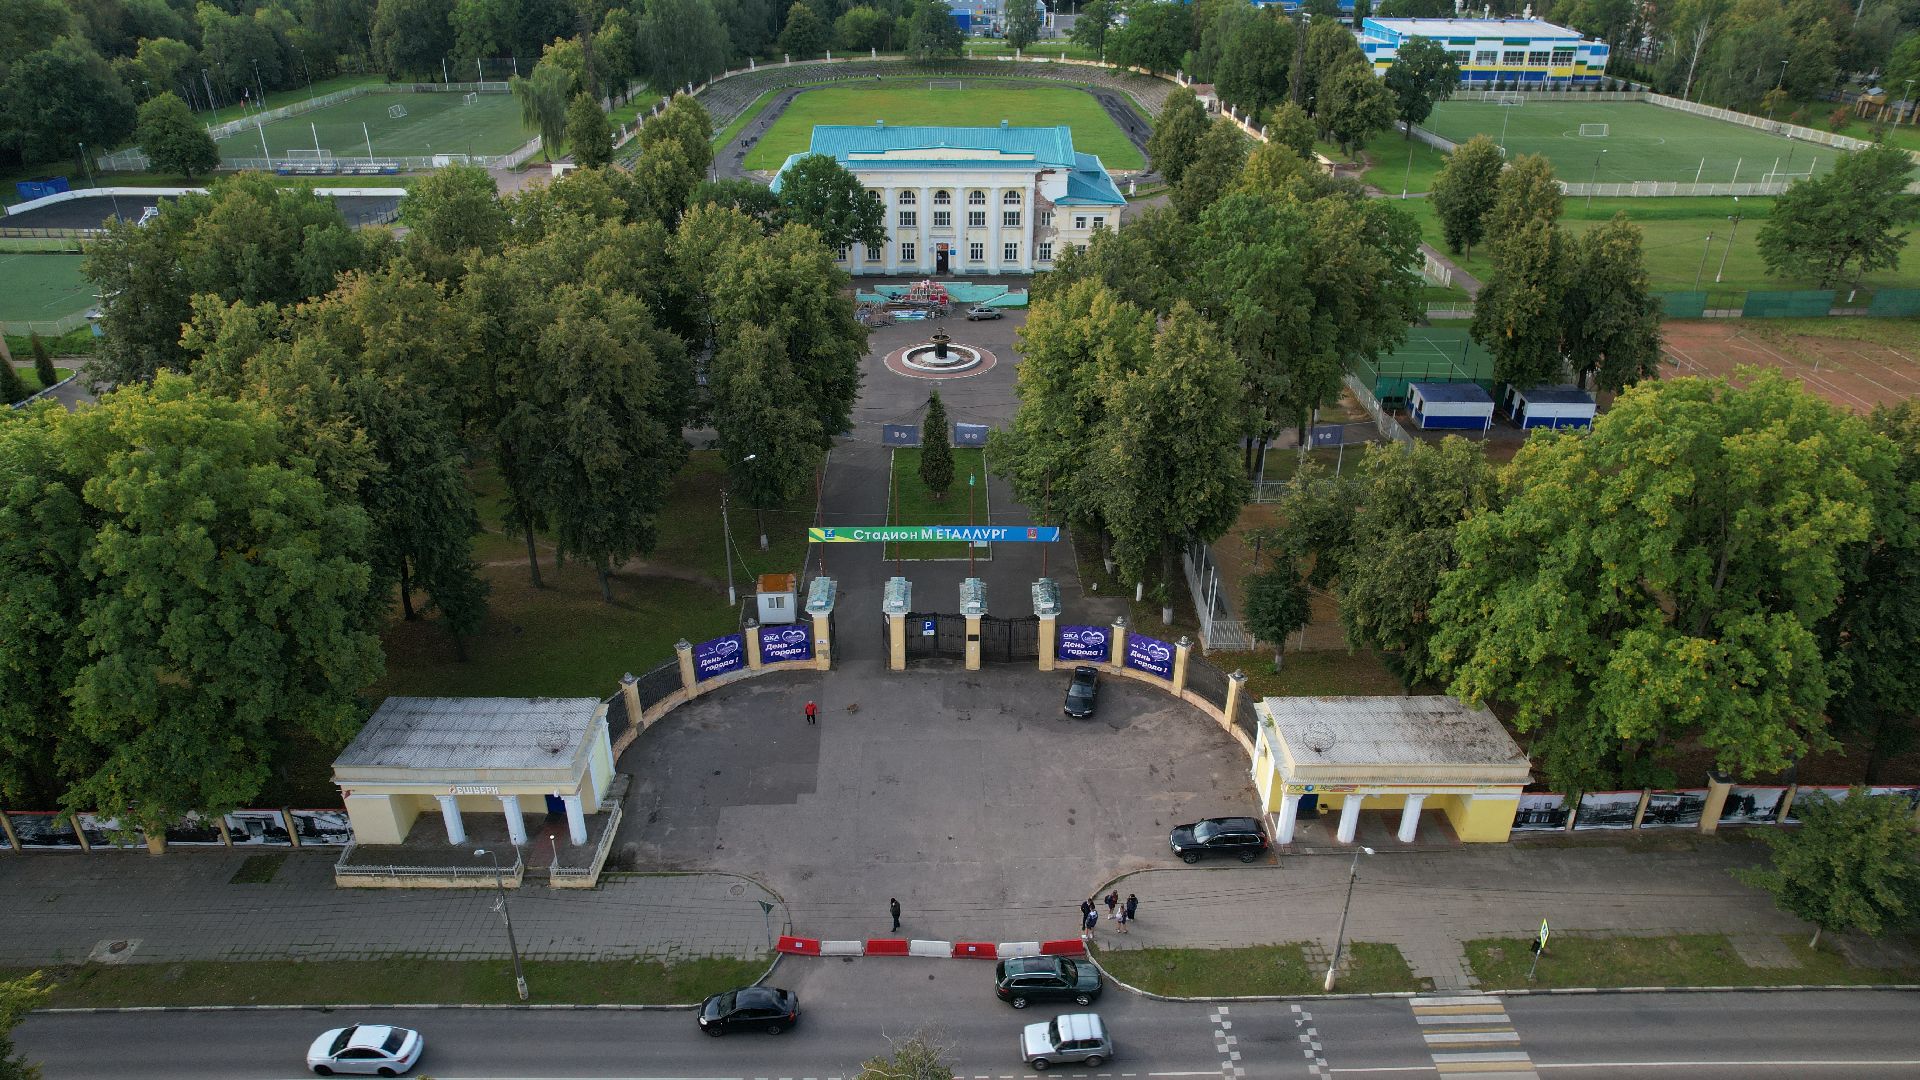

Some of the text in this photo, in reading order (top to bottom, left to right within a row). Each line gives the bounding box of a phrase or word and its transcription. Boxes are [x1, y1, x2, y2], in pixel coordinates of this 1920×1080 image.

[853, 528, 1008, 541] Стадион МЕТАЛЛУРГ
[925, 621, 932, 630] P
[765, 643, 788, 651] День
[1062, 641, 1086, 649] День
[1130, 650, 1151, 662] День
[700, 656, 722, 668] День
